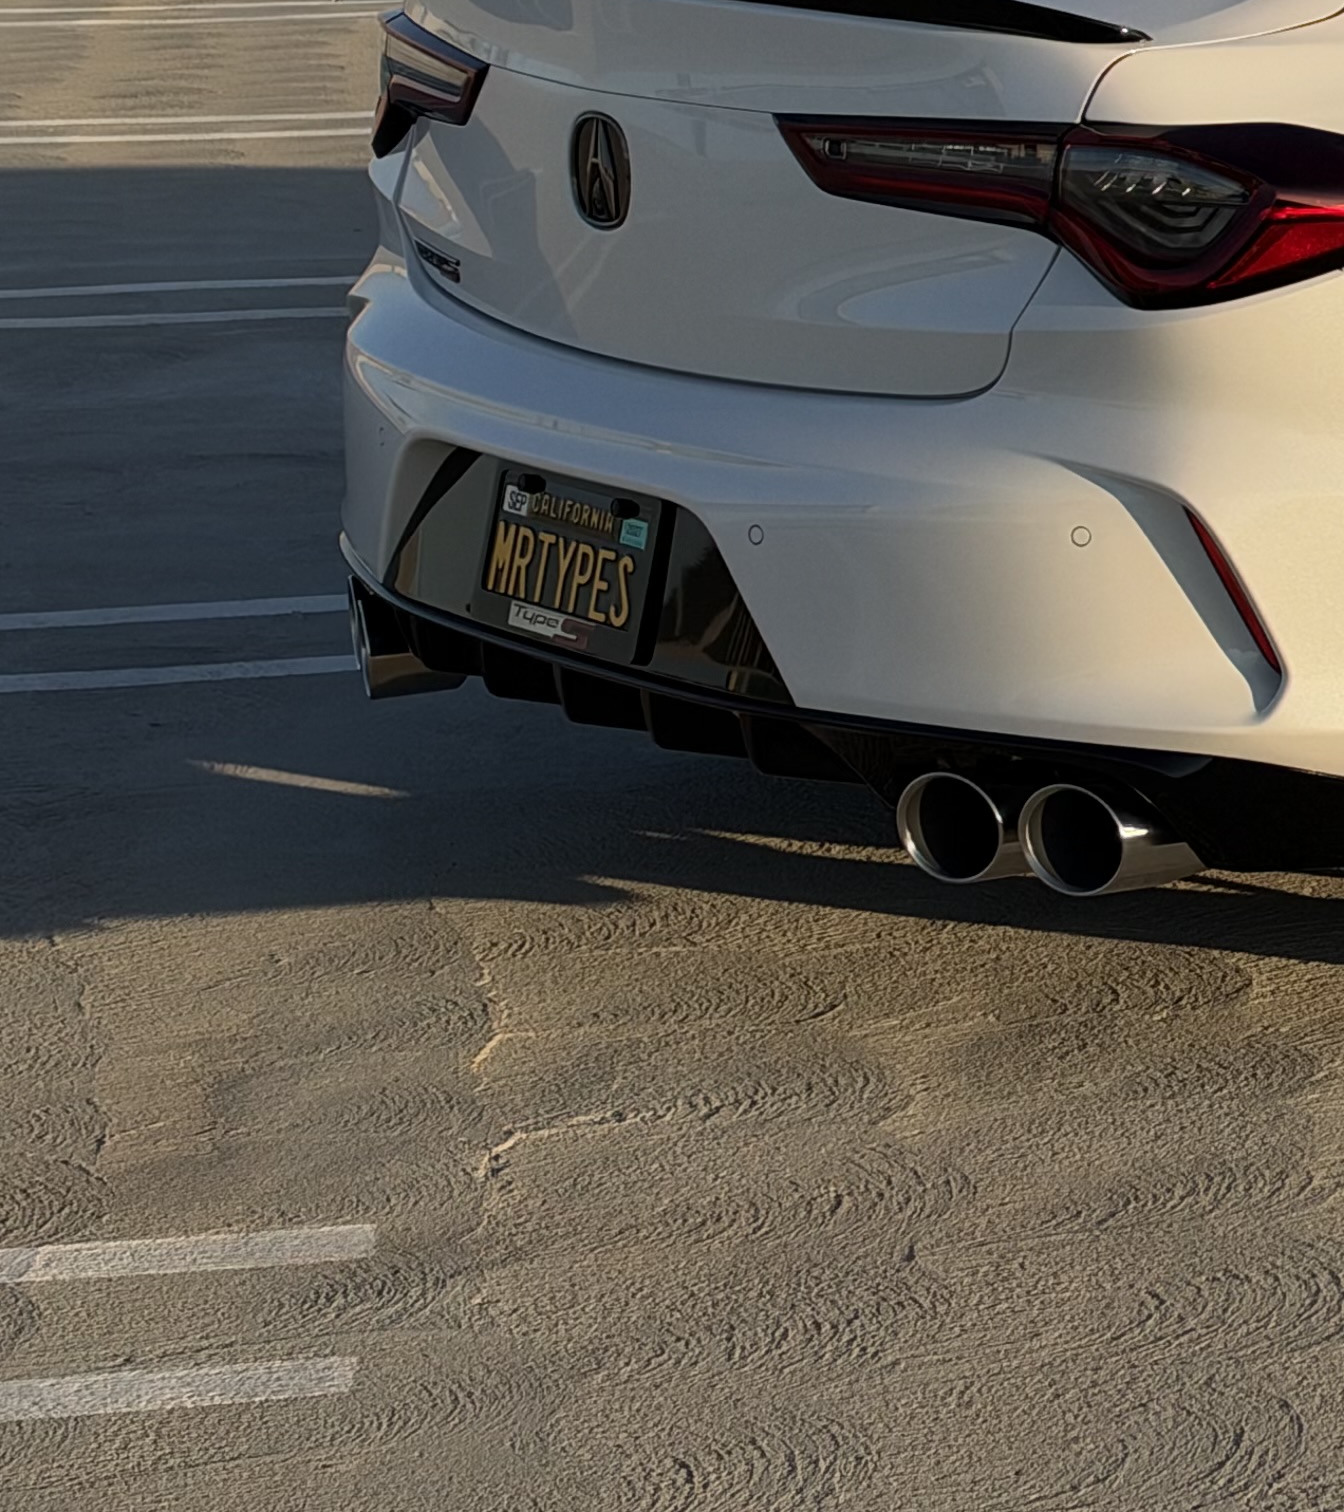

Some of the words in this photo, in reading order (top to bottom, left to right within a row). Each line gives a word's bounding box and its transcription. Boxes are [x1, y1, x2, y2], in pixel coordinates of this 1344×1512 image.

[531, 492, 615, 534] CALIFORNIA
[486, 519, 636, 629] MRTYPES
[513, 603, 560, 630] Type
[551, 618, 597, 649] S
